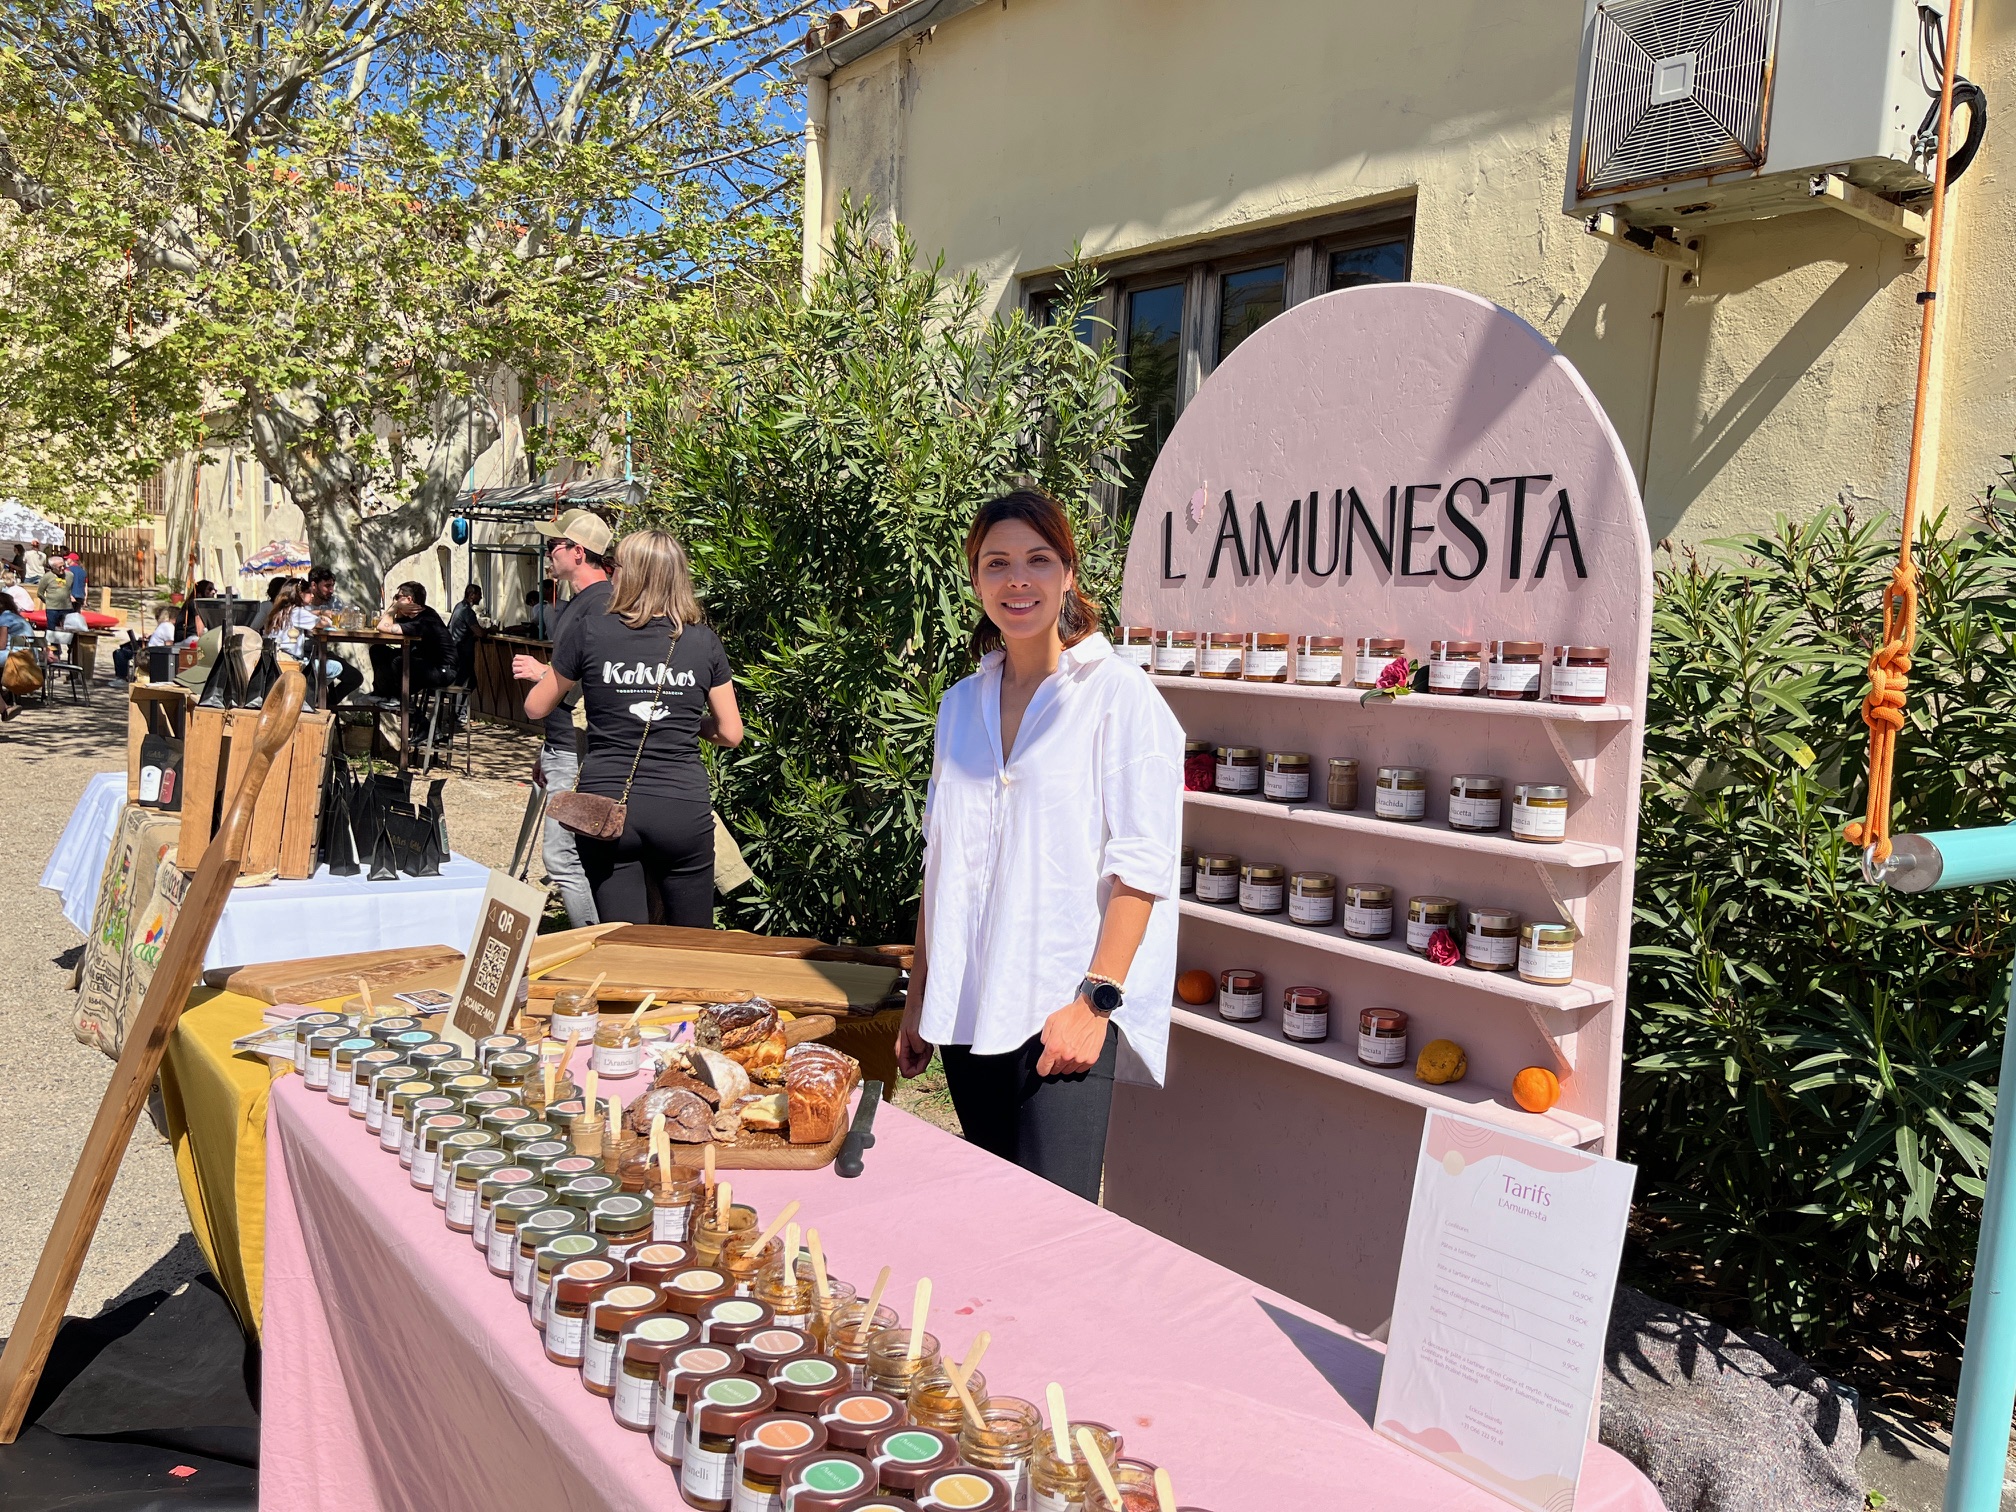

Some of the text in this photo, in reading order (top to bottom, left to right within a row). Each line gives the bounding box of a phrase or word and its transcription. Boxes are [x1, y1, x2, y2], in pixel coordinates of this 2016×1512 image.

[498, 910, 515, 934] QR
[464, 995, 496, 1023] SCANEZ-MOI
[604, 1058, 634, 1067] L'Arancia
[1502, 1174, 1552, 1206] Tarifs
[1498, 1198, 1547, 1222] L'Amunesta
[1444, 1220, 1470, 1233] Confitures
[1458, 1247, 1477, 1259] tartiner
[1452, 1268, 1471, 1280] tartiner
[1471, 1276, 1492, 1288] pistache
[1466, 1358, 1485, 1370] tartiner
[1486, 1367, 1501, 1377] citron
[1502, 1374, 1518, 1385] Corse
[1460, 1364, 1475, 1374] citron
[1493, 1379, 1513, 1392] vinaigre
[1515, 1388, 1545, 1405] balsamique
